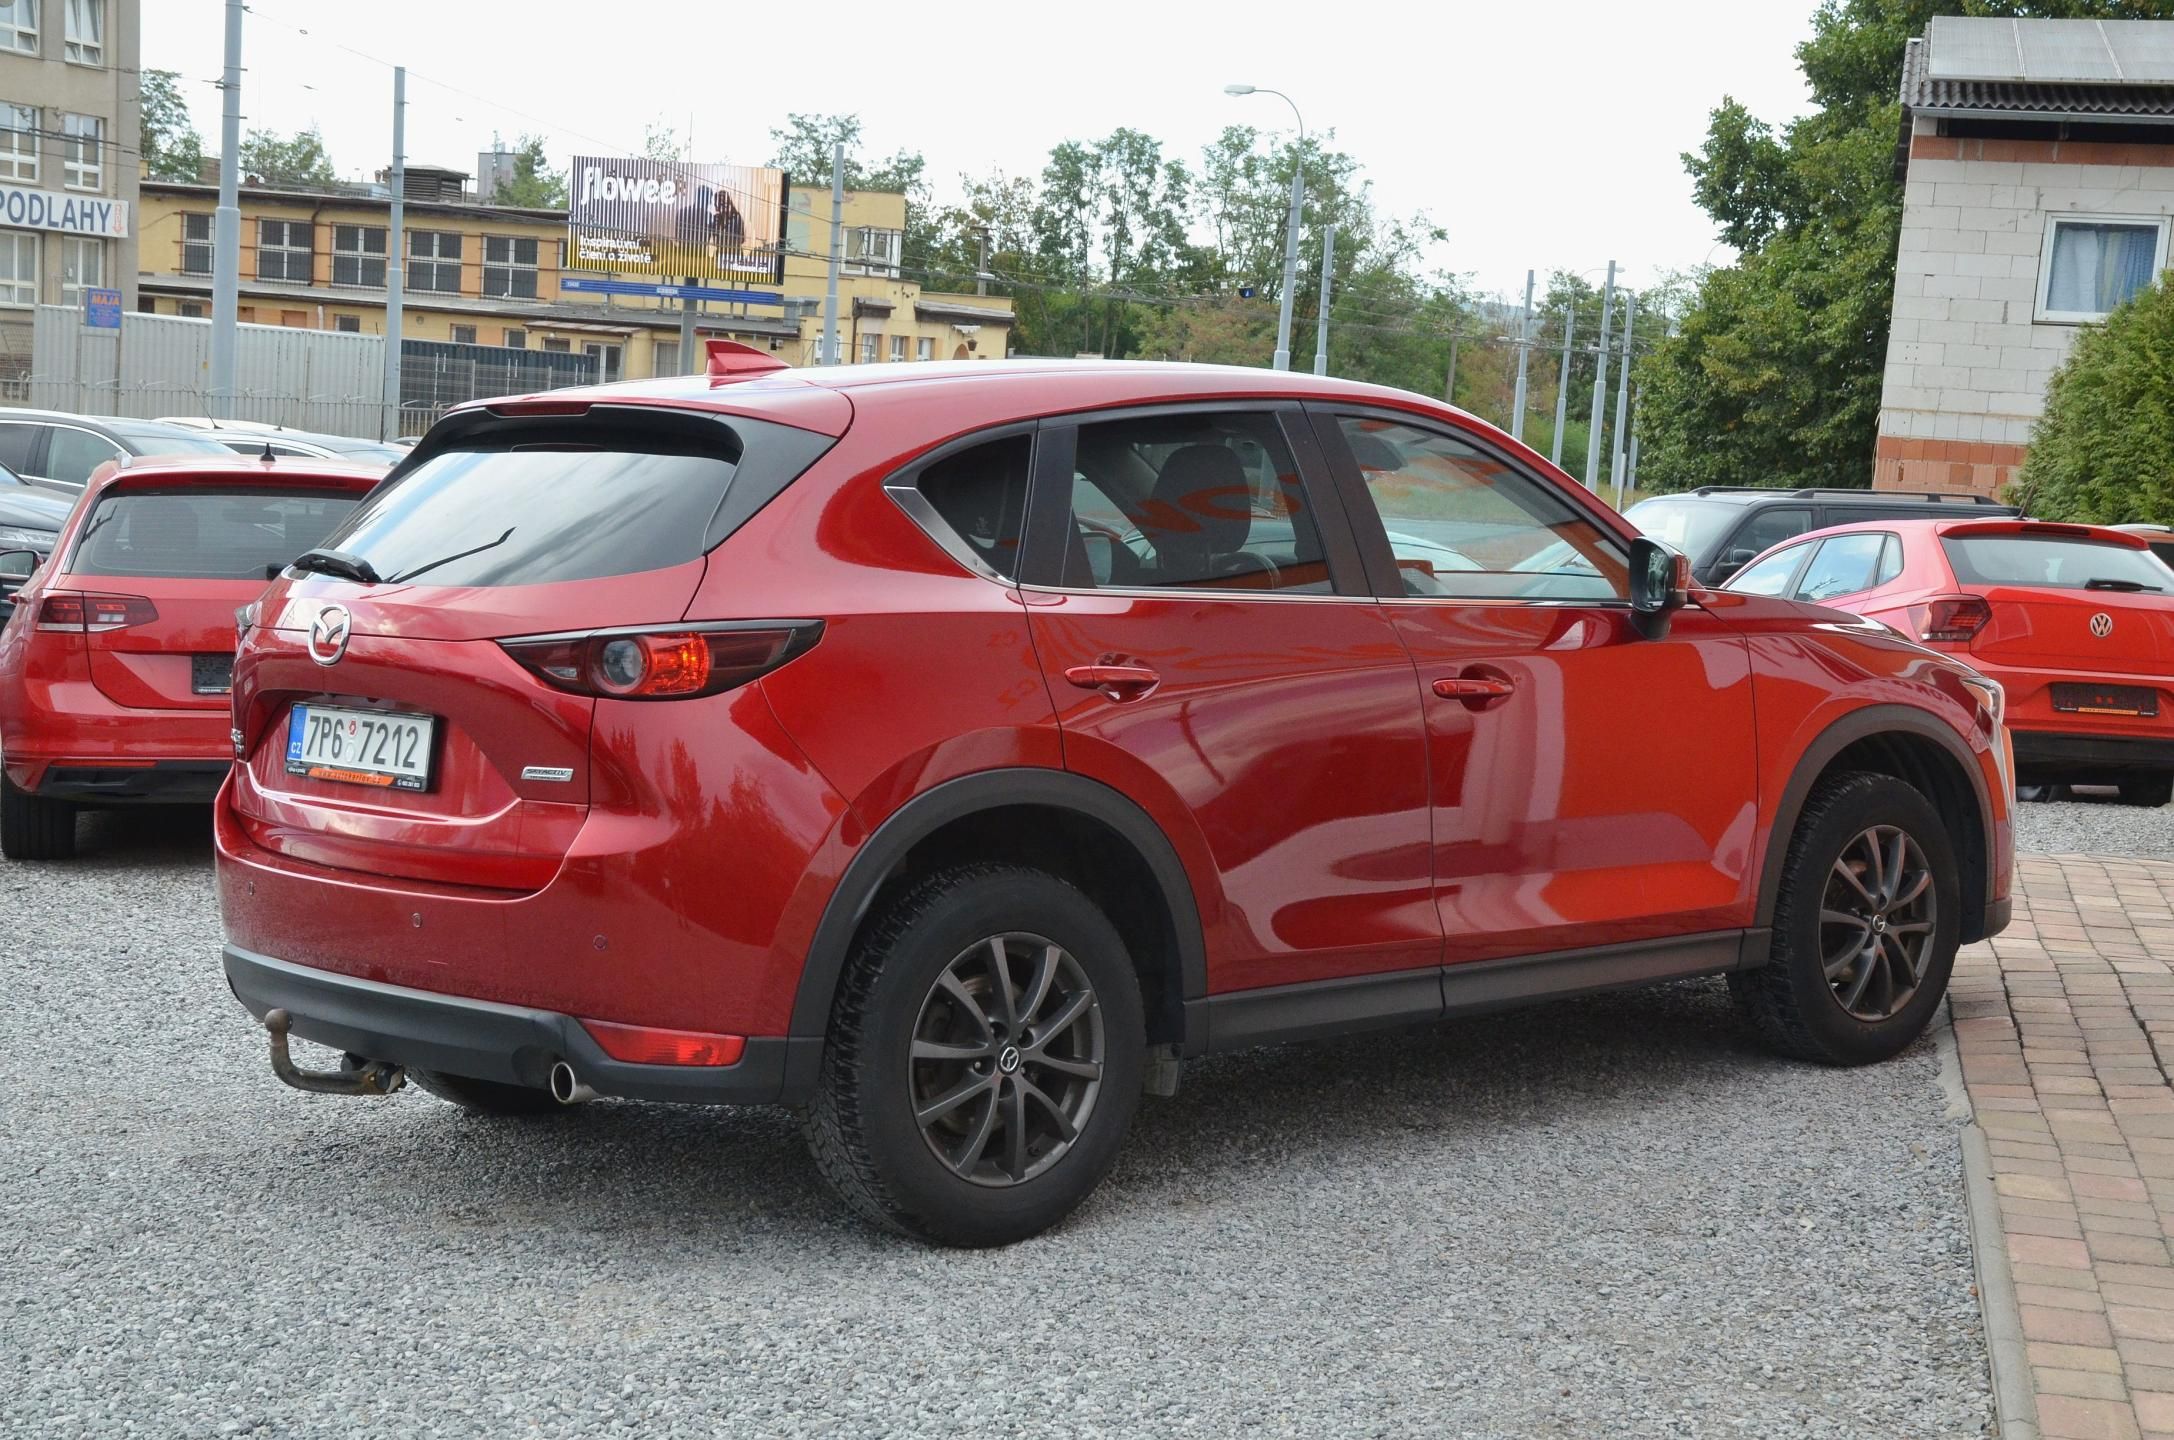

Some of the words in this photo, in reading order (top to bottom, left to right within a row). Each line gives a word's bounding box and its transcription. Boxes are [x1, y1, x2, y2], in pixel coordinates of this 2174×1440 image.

[580, 166, 676, 206] flowee
[578, 248, 606, 261] čtení
[608, 253, 615, 261] o
[290, 742, 301, 754] CZ
[306, 715, 344, 759] 7P6
[358, 721, 419, 768] 7212
